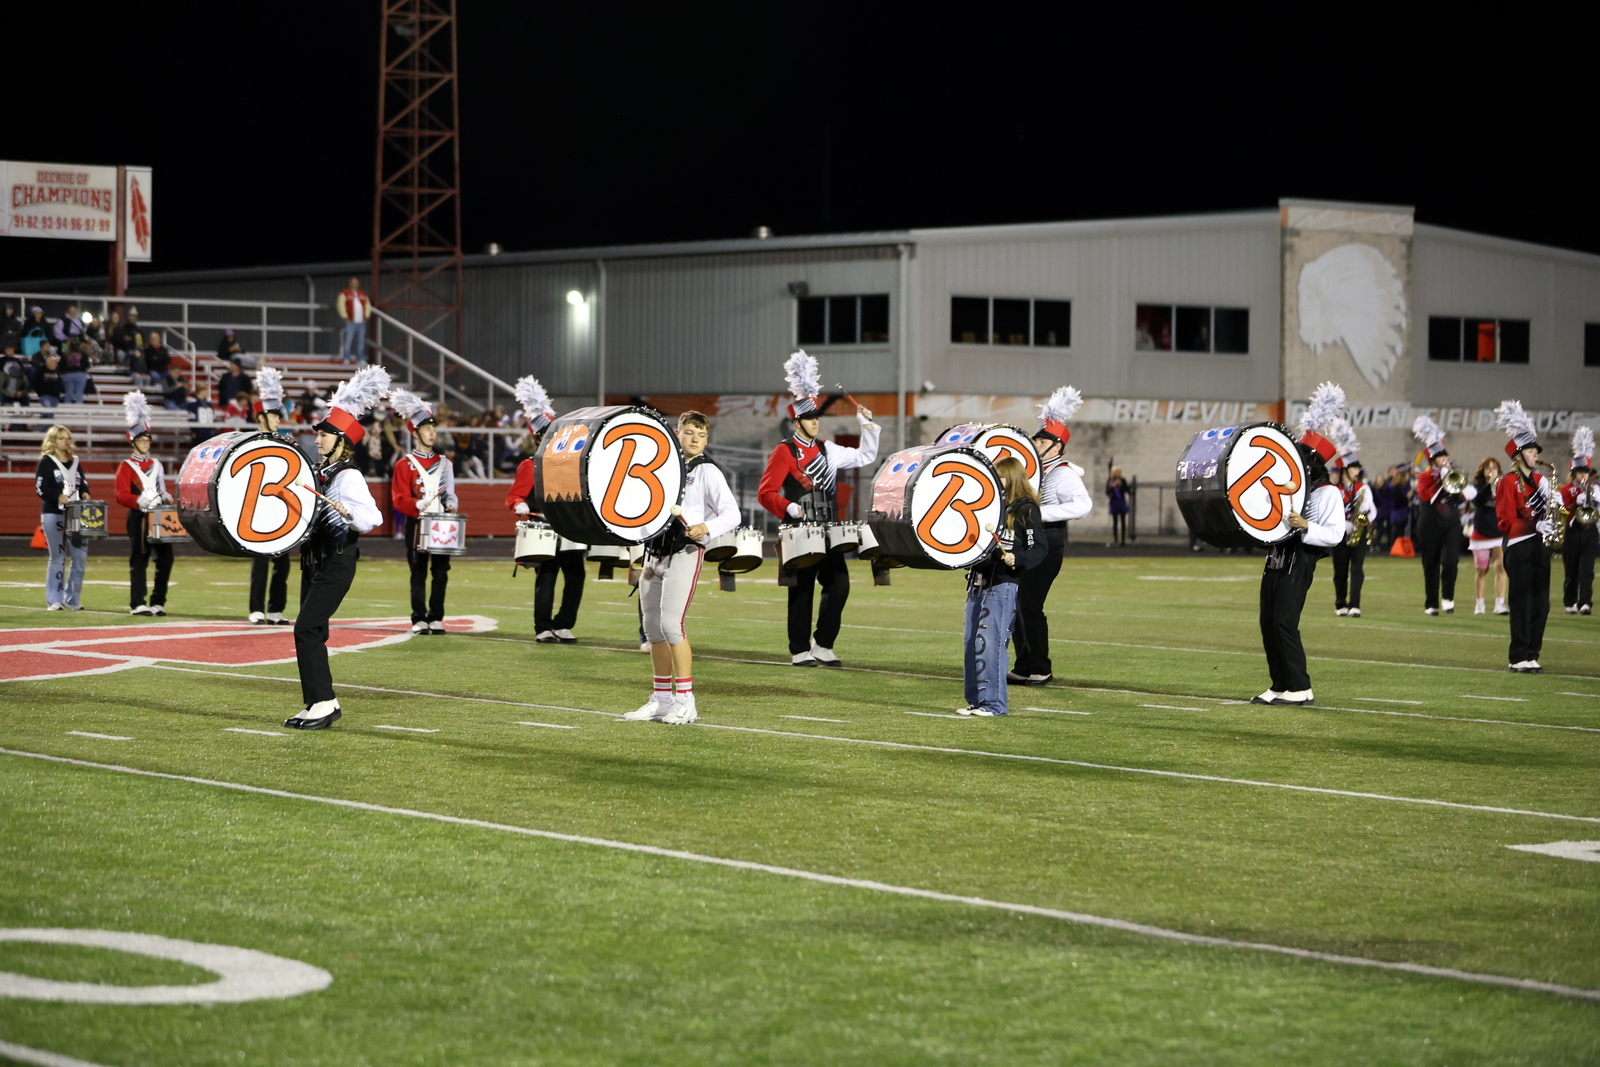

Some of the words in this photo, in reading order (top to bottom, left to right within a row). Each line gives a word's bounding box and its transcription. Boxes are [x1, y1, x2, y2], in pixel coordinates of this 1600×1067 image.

[13, 184, 112, 213] CHAMPIONS
[37, 170, 75, 184] DECADE
[77, 173, 89, 185] OF
[1114, 399, 1257, 424] BELLEVUE
[230, 446, 302, 543] B
[600, 422, 671, 528] B
[916, 461, 995, 554] B
[1228, 435, 1302, 531] B
